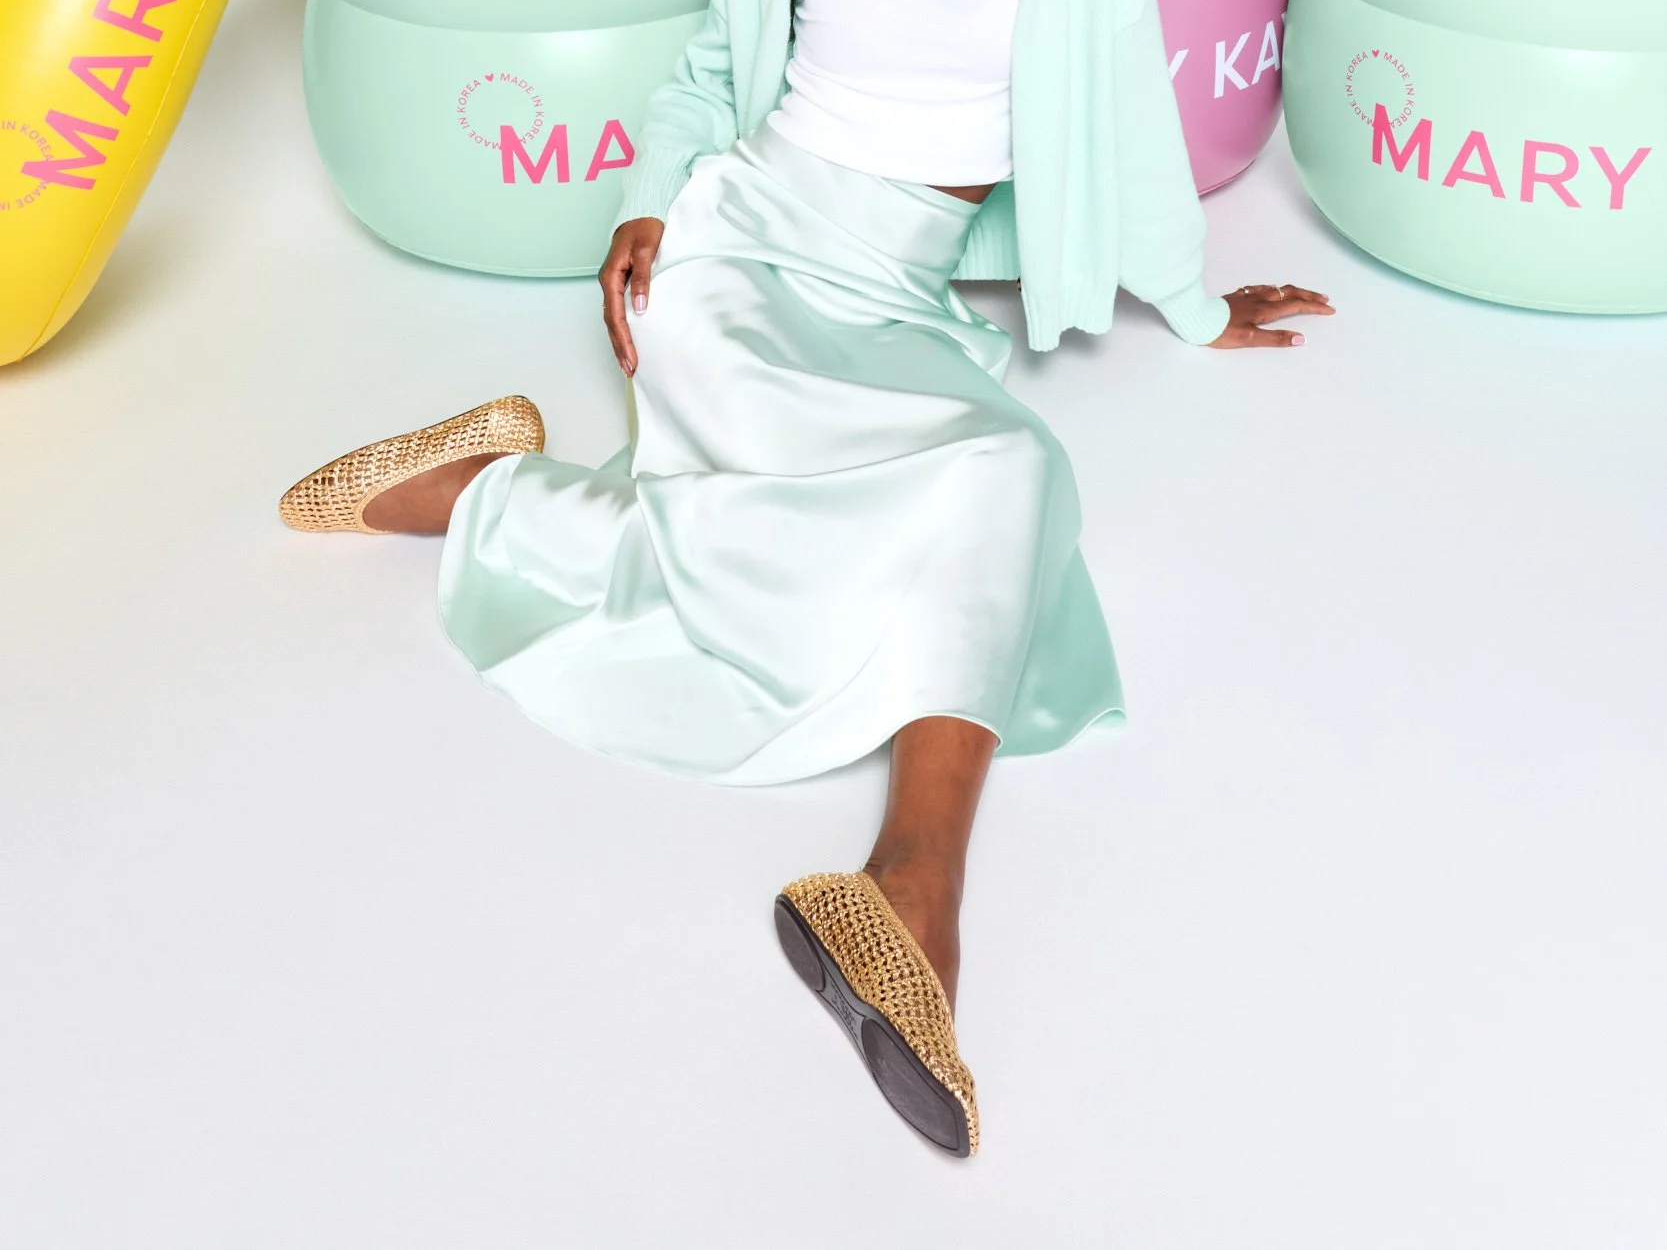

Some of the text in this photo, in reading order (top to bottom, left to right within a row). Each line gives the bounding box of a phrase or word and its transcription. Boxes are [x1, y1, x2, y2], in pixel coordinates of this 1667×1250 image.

[1214, 12, 1287, 99] KA
[1346, 51, 1368, 81] KOREA
[1383, 52, 1410, 80] MADE
[1346, 84, 1353, 97] IN
[1405, 83, 1414, 95] IN
[2, 121, 16, 130] IN
[457, 73, 544, 151] MADE IN KOREA MADE IN KOREA
[499, 119, 636, 184] MA
[1371, 102, 1653, 210] MARY
